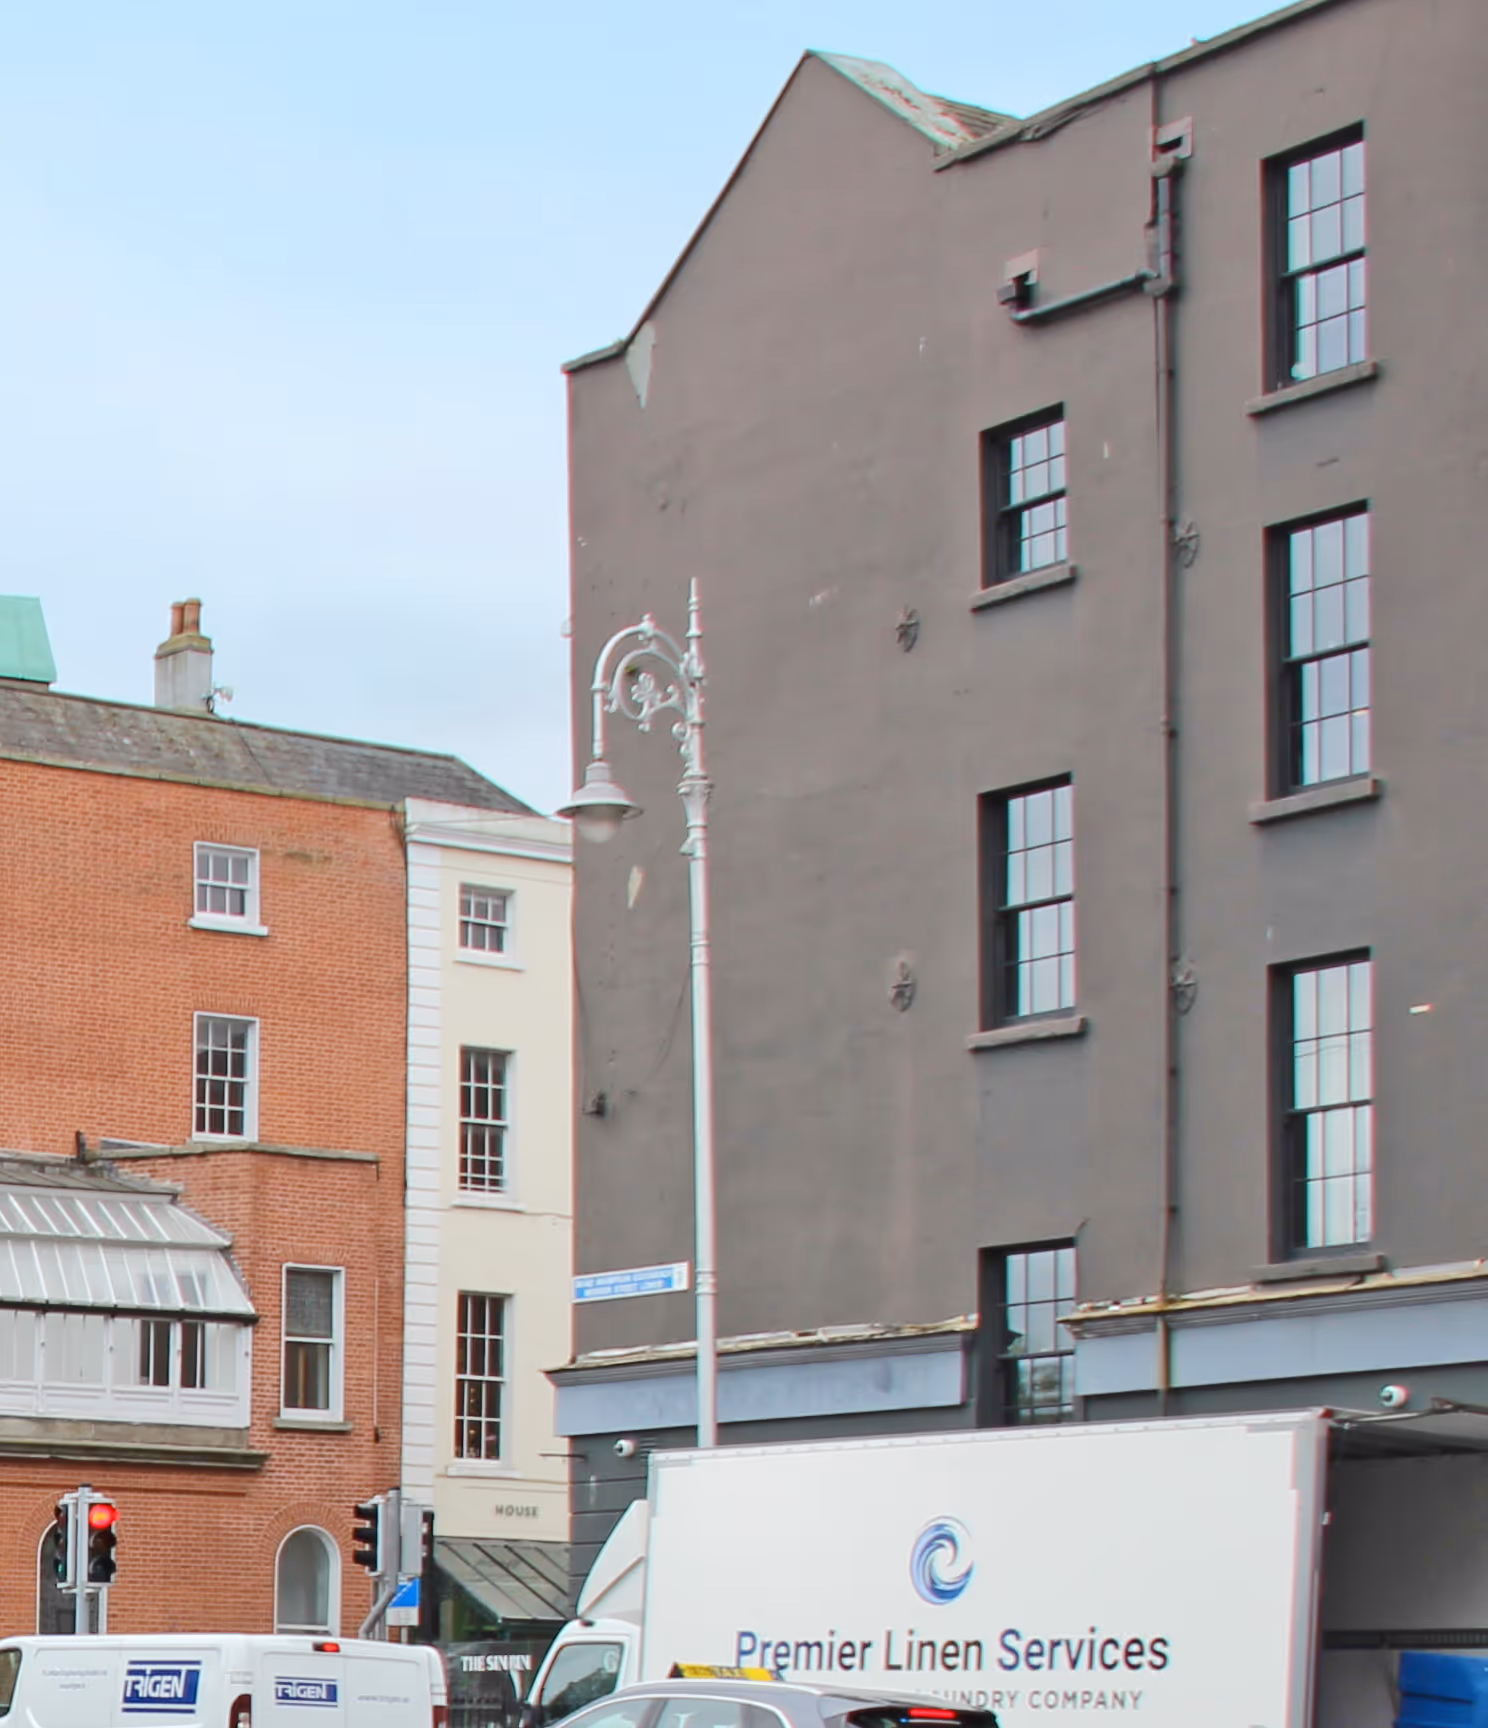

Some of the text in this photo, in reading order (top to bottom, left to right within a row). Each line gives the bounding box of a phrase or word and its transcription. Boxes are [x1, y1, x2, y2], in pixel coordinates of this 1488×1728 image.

[494, 1505, 539, 1518] HOUSE
[735, 1626, 1170, 1671] Premier Linen Services
[461, 1655, 486, 1672] THE
[915, 1690, 1143, 1709] UNDRY COMPANY
